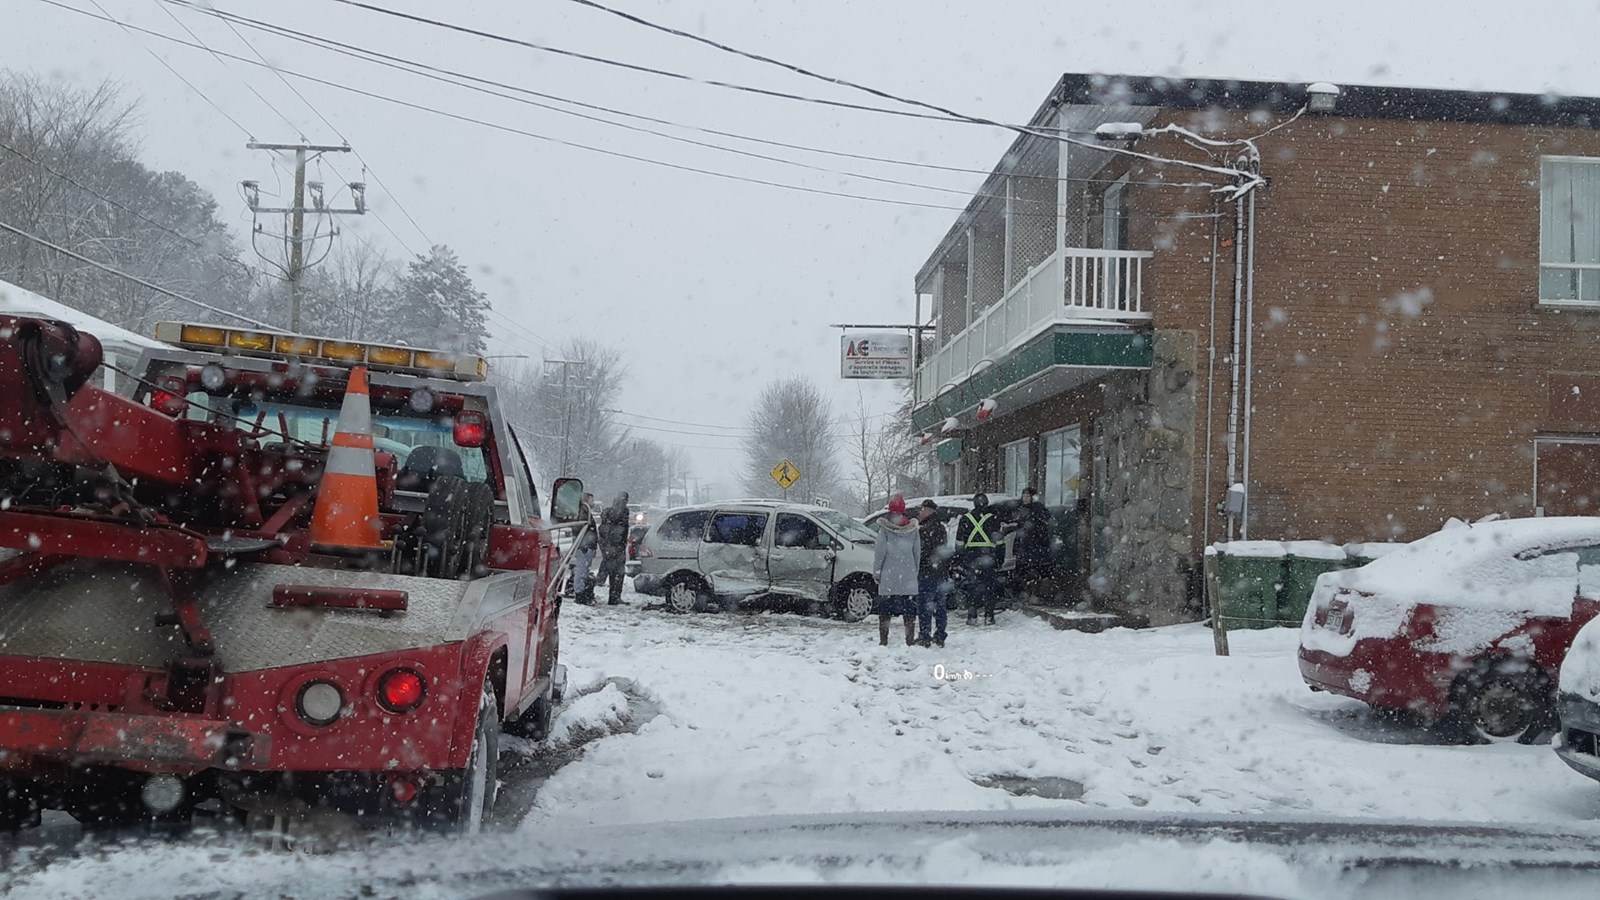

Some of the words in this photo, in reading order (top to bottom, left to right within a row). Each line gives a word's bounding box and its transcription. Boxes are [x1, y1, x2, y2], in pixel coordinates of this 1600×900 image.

[815, 499, 828, 508] 50
[934, 664, 945, 680] 0
[945, 672, 962, 680] km/h
